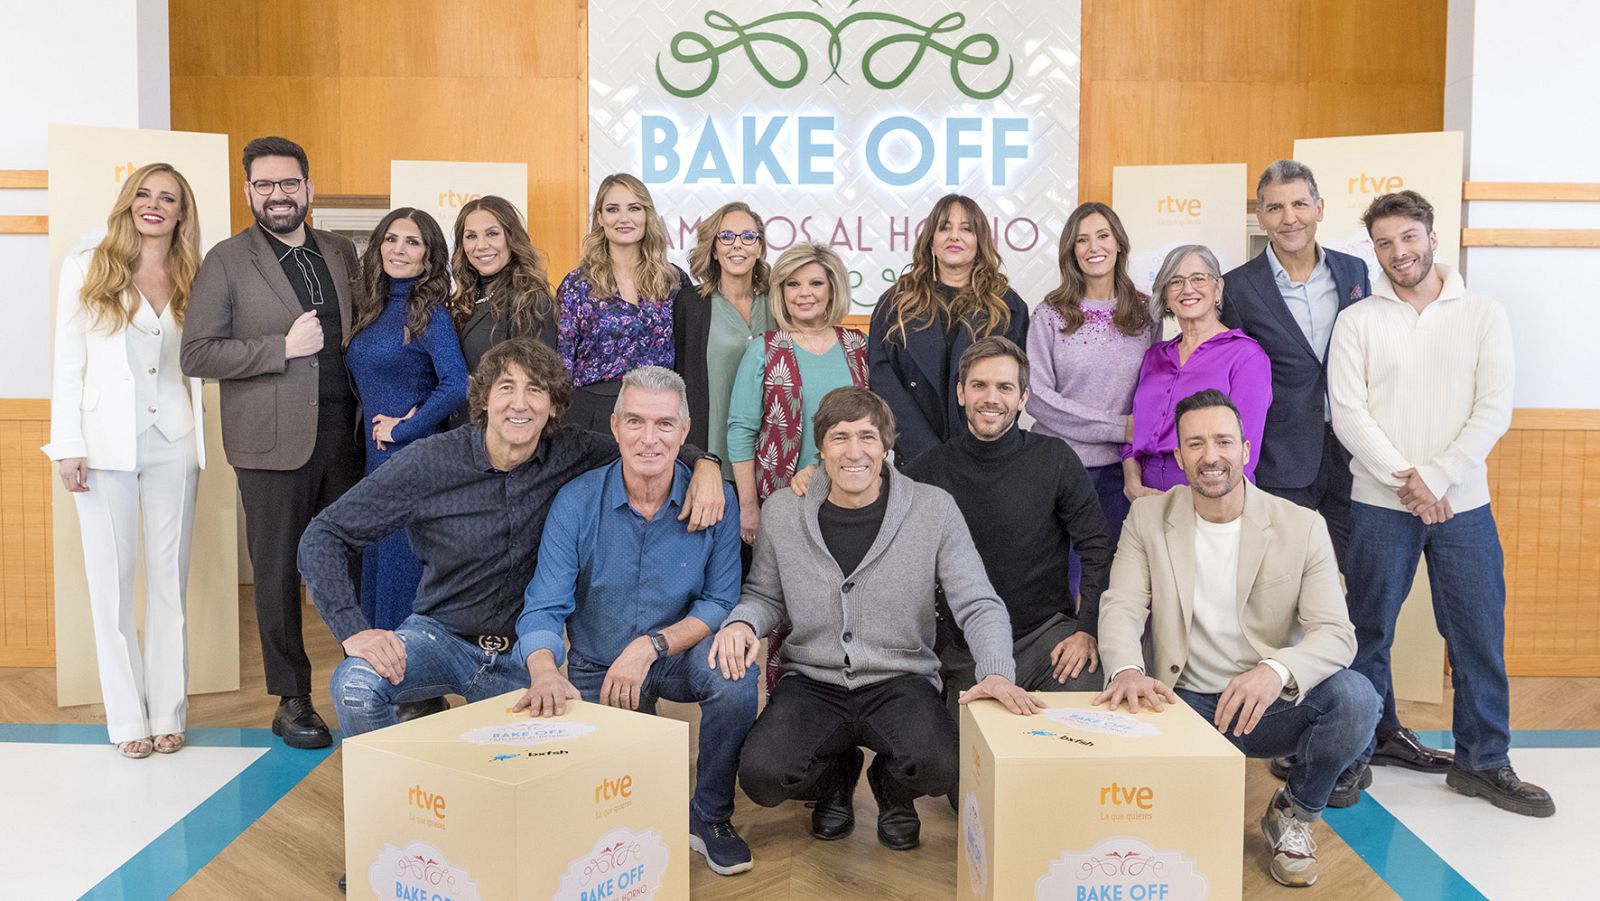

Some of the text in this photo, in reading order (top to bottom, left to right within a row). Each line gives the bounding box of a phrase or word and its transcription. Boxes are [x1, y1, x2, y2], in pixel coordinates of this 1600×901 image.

[641, 114, 1029, 186] BAKE OFF
[1347, 172, 1404, 194] rtve
[1157, 195, 1202, 217] rtve
[828, 216, 873, 252] AL
[408, 784, 446, 819] rtve
[595, 775, 632, 805] rtve
[1100, 782, 1154, 810] rtve
[617, 864, 645, 889] OFF
[1077, 883, 1169, 901] BAKE OFF
